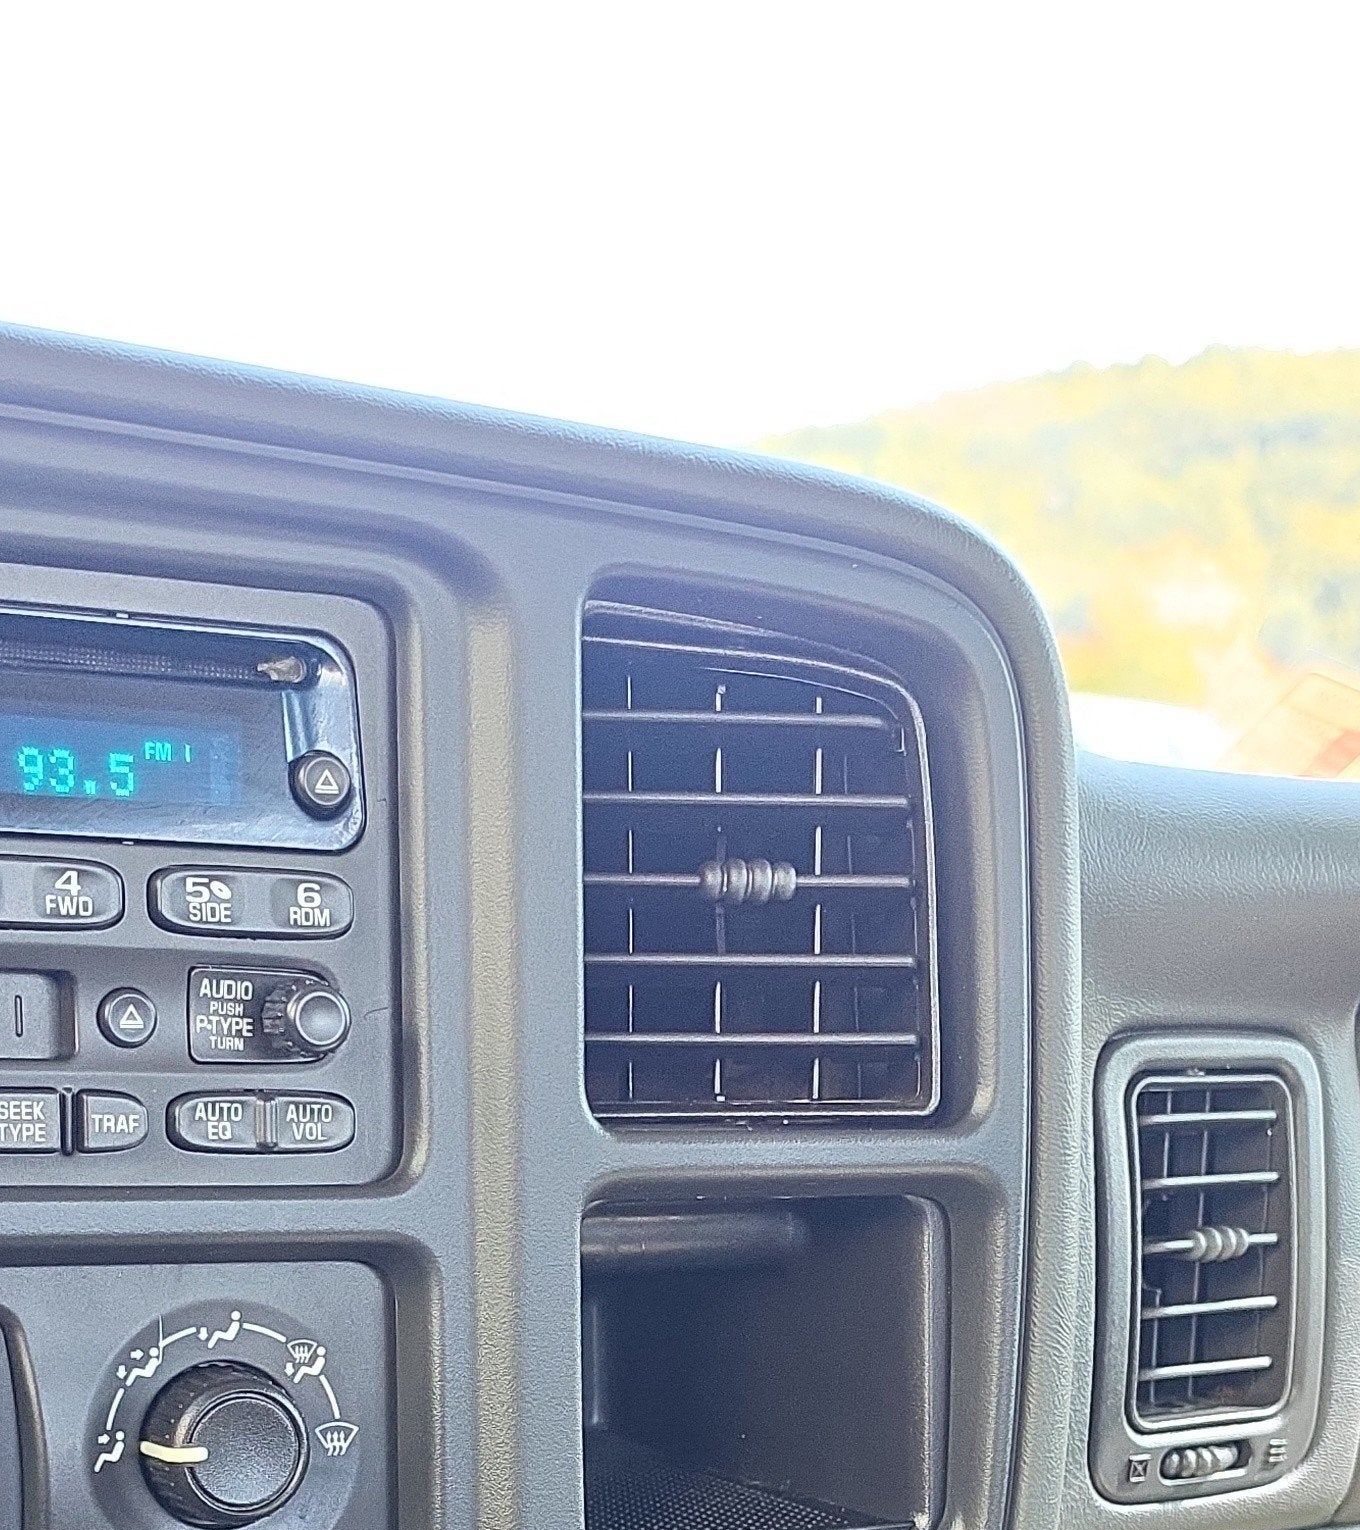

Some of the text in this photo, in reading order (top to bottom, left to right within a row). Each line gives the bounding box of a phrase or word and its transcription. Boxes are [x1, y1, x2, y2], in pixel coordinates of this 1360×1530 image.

[145, 742, 173, 762] FM
[18, 746, 134, 796] 93.5
[54, 871, 81, 895] 4
[185, 877, 209, 901] 5
[296, 883, 321, 907] 6
[45, 895, 93, 917] FWD
[189, 903, 232, 923] SIDE
[289, 907, 330, 927] RDM
[199, 978, 253, 1000] AUDIO
[209, 1002, 243, 1015] PUSH
[196, 1015, 254, 1037] P-TYPE
[209, 1036, 244, 1051] TURN
[194, 1103, 243, 1121] AUTO
[286, 1104, 332, 1123] AUTO
[91, 1114, 139, 1133] TRAF
[207, 1122, 232, 1140] EQ
[292, 1123, 327, 1141] VOL
